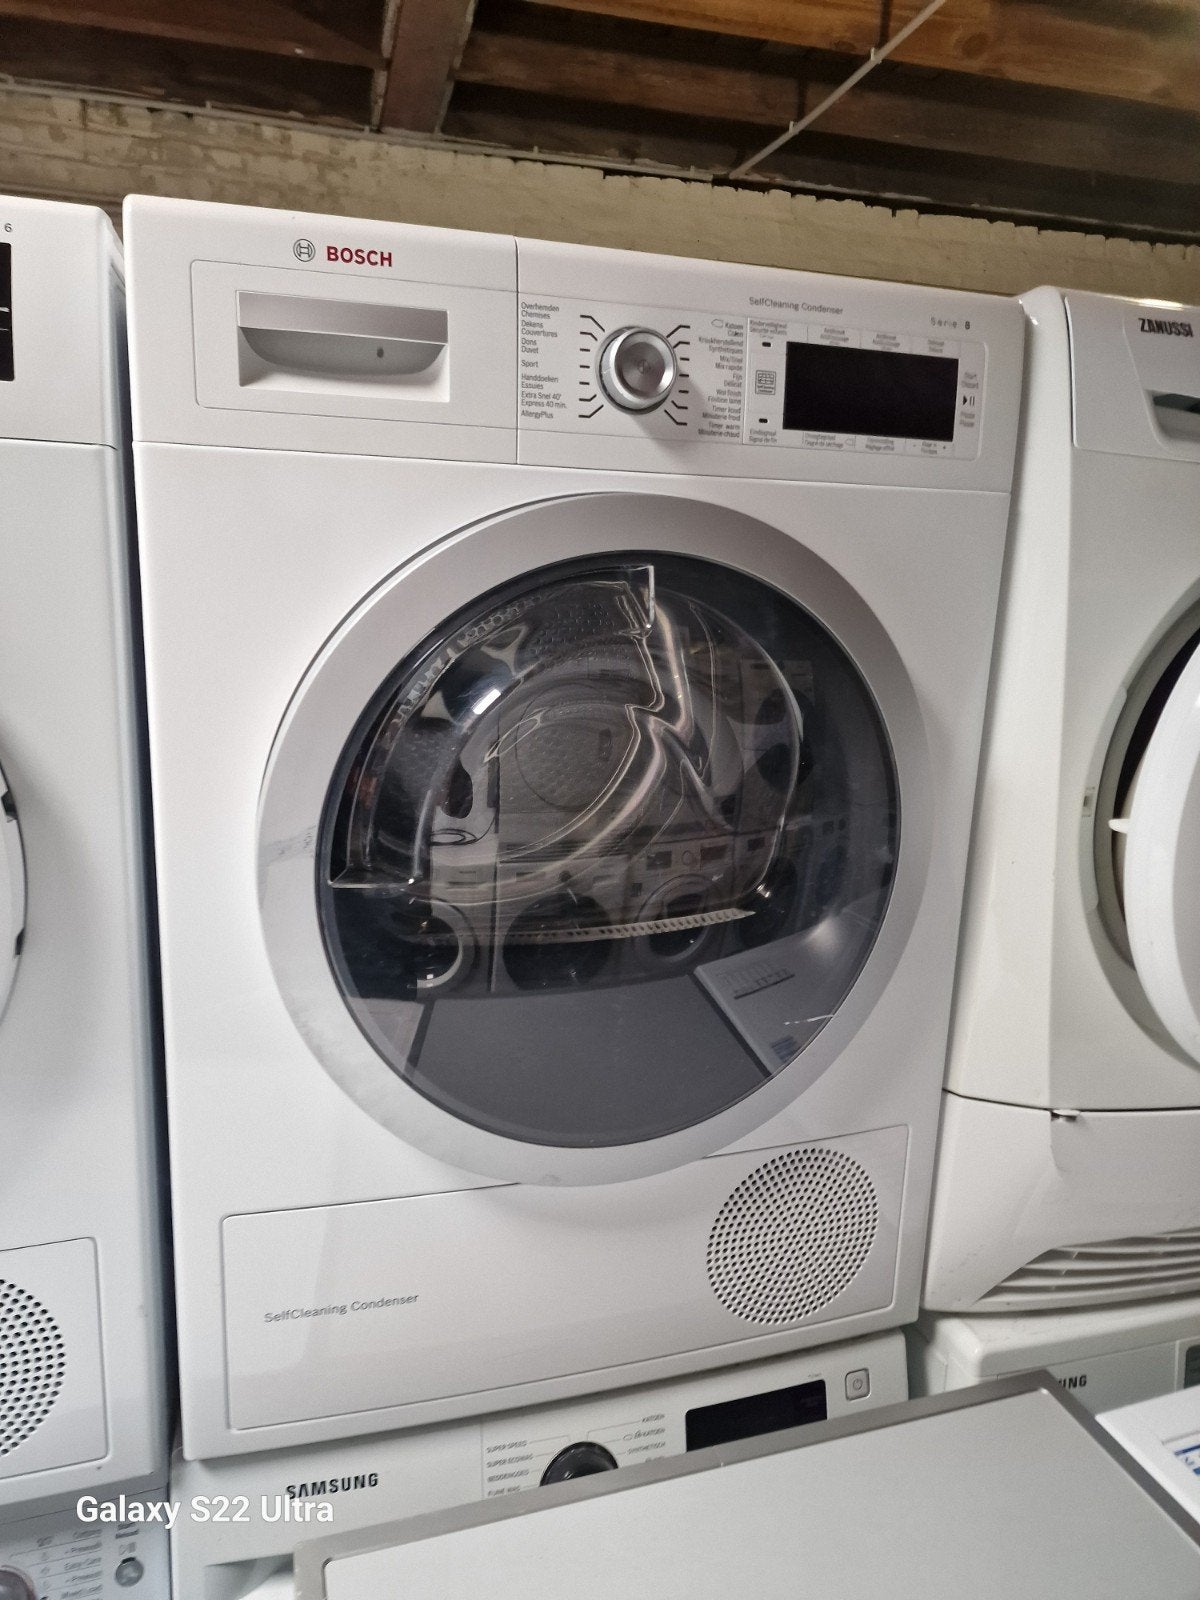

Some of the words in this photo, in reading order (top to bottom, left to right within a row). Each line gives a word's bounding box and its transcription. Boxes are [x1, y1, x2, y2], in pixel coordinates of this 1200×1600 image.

[4, 222, 13, 233] 6
[326, 245, 393, 267] BOSCH
[520, 302, 560, 312] Overhemden
[749, 296, 800, 311] SelfCleaning
[801, 302, 844, 315] Condenser
[520, 310, 551, 320] Chemises
[521, 321, 544, 329] Dekens
[931, 316, 958, 329] Serie
[964, 320, 971, 330] 8
[1138, 317, 1194, 338] ZANUSSI
[521, 328, 558, 338] Couvertures
[521, 338, 537, 346] Dons
[521, 346, 539, 354] Duvet
[521, 374, 559, 383] Handdoeken
[521, 400, 545, 409] Express
[520, 410, 554, 419] AllergyPlus
[264, 1302, 348, 1323] SelfCleaning
[350, 1294, 419, 1312] Condenser
[285, 1472, 379, 1500] SAMSUNG
